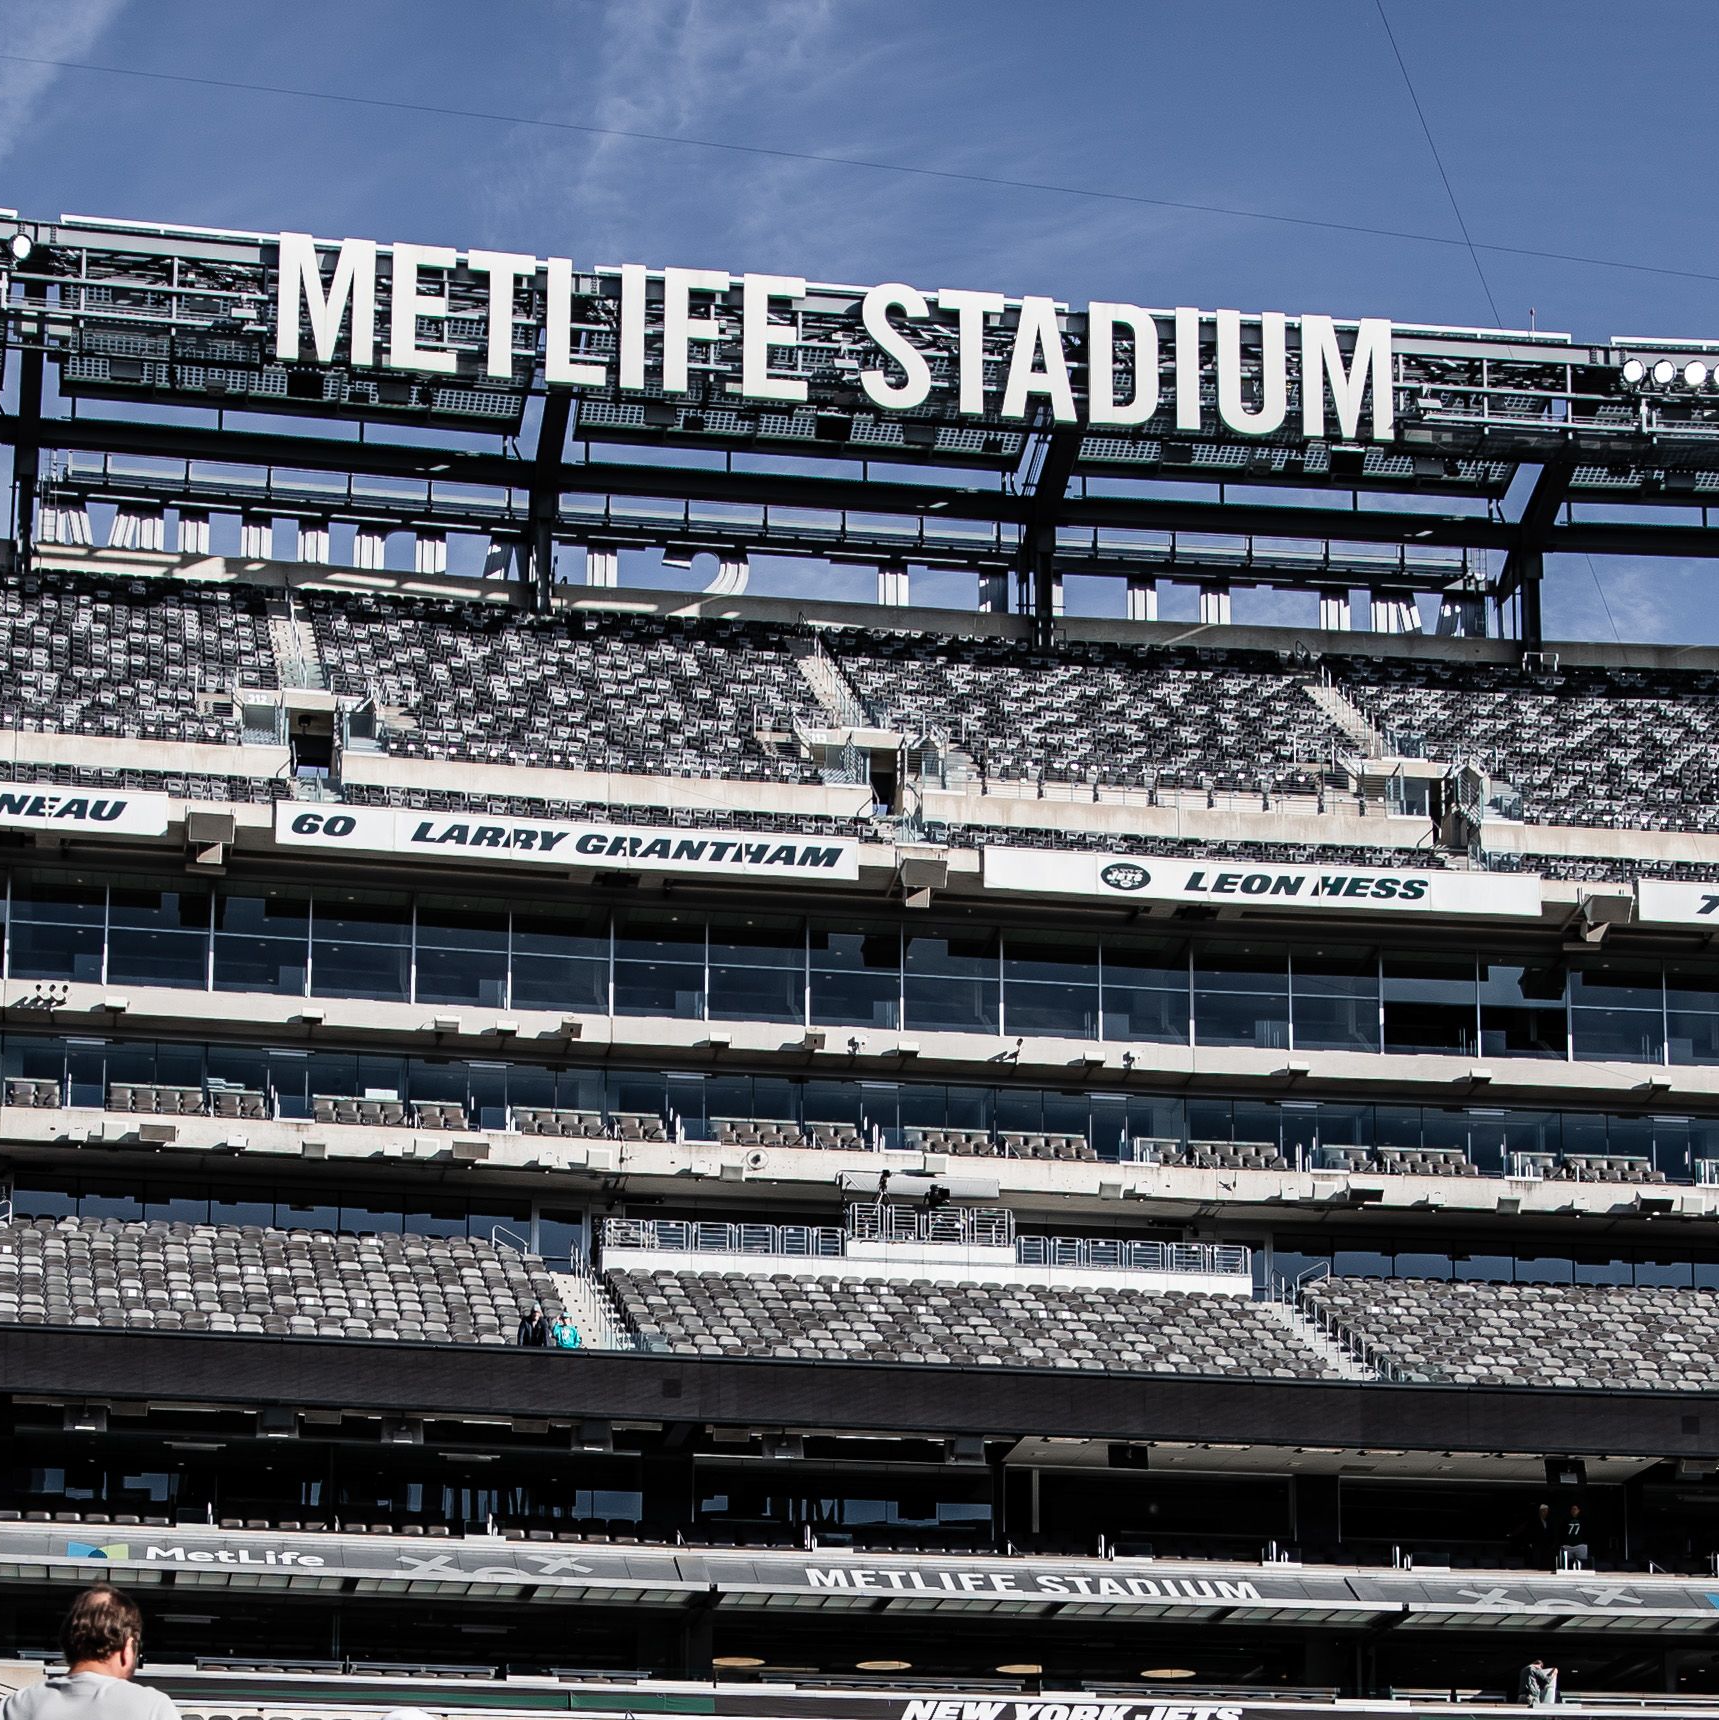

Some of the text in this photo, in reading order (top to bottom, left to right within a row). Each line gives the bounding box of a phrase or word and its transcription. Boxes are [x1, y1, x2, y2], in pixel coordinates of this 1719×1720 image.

[275, 231, 1395, 442] METLIFE STADIUM
[290, 813, 844, 868] 60 LARRY GRANTHAM
[1183, 871, 1430, 900] LEON HESS
[1568, 1523, 1580, 1535] 77
[145, 1545, 325, 1567] MetLife
[805, 1567, 1262, 1600] METLIFE STADIUM
